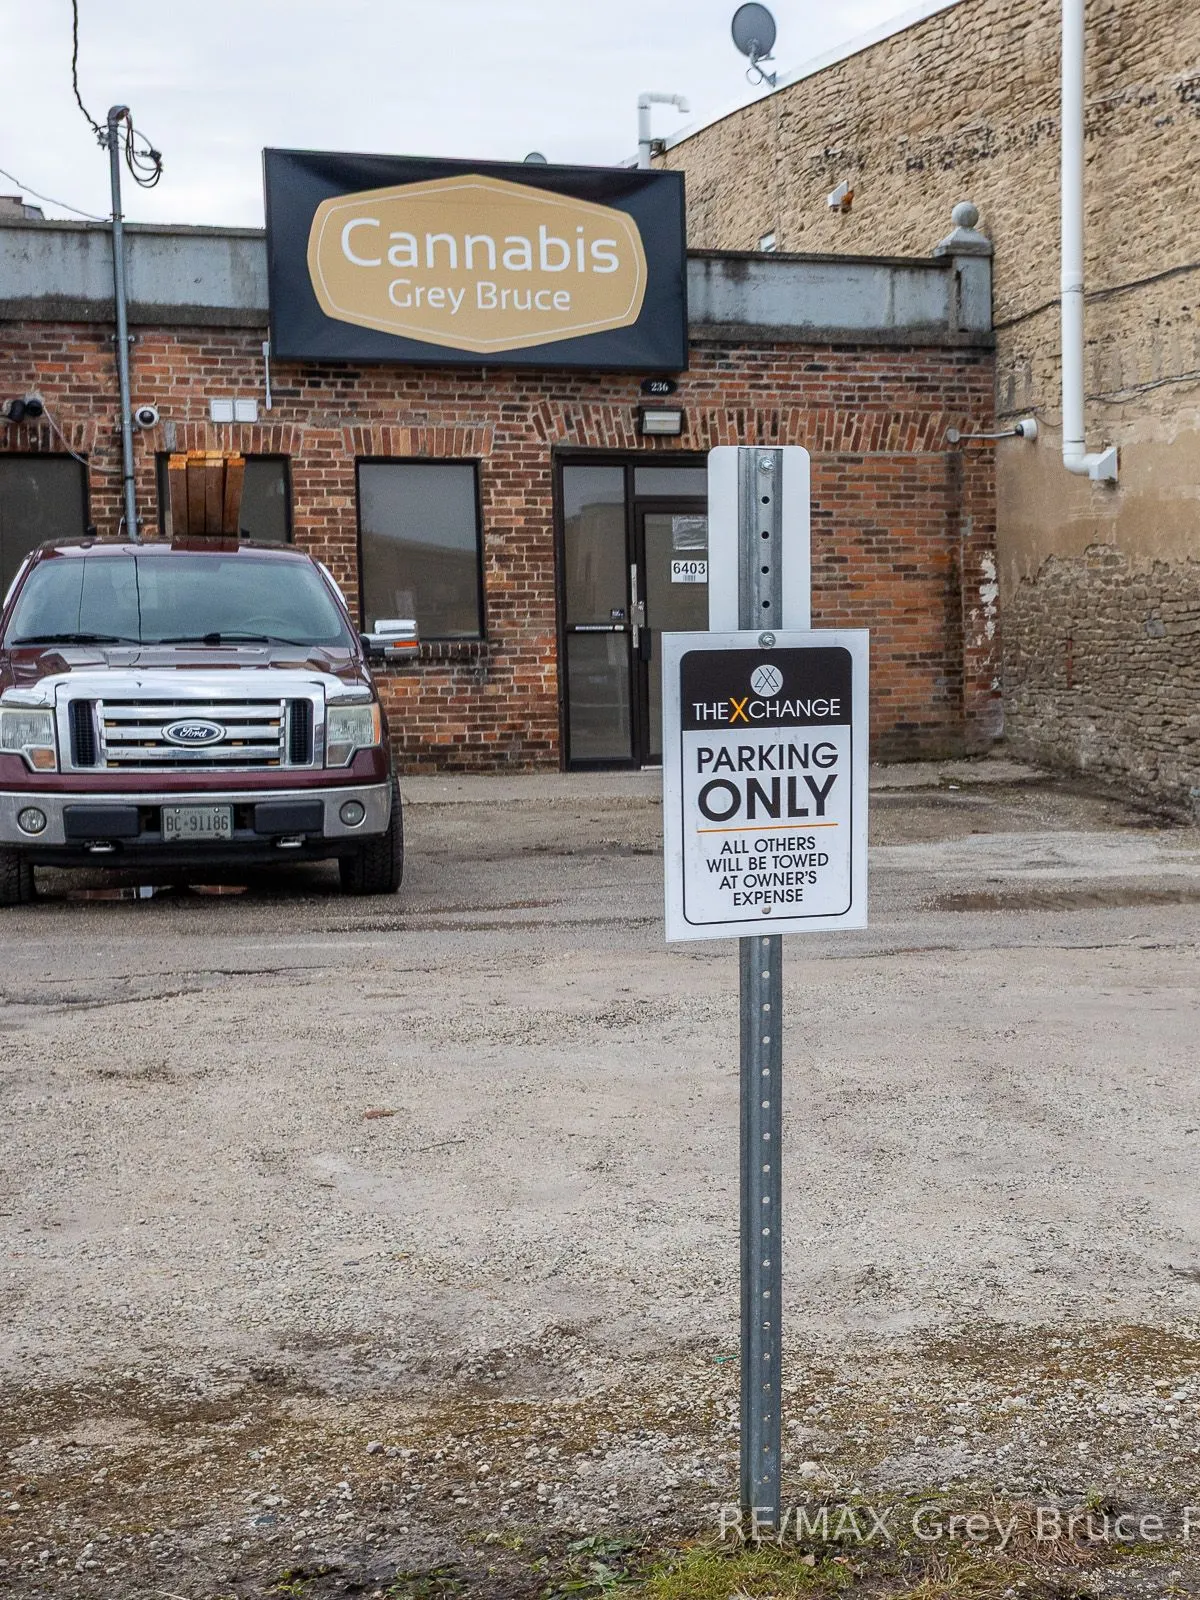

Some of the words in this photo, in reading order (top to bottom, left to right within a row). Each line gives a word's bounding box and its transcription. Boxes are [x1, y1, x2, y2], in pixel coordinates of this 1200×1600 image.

[340, 216, 620, 274] Cannabis
[388, 278, 466, 315] Grey
[476, 281, 571, 312] Bruce
[650, 382, 668, 392] 236
[673, 562, 706, 575] 6403
[180, 726, 207, 738] Ford
[697, 742, 839, 774] PARKING
[697, 774, 838, 823] ONLY
[190, 815, 229, 831] 91186
[720, 840, 749, 855] ALL
[754, 836, 816, 853] OTHERS
[706, 857, 743, 873] WILL
[749, 857, 767, 871] BE
[772, 853, 829, 870] TOWED
[719, 875, 738, 890] AT
[743, 870, 817, 889] OWNER'S
[733, 888, 804, 906] EXPENSE
